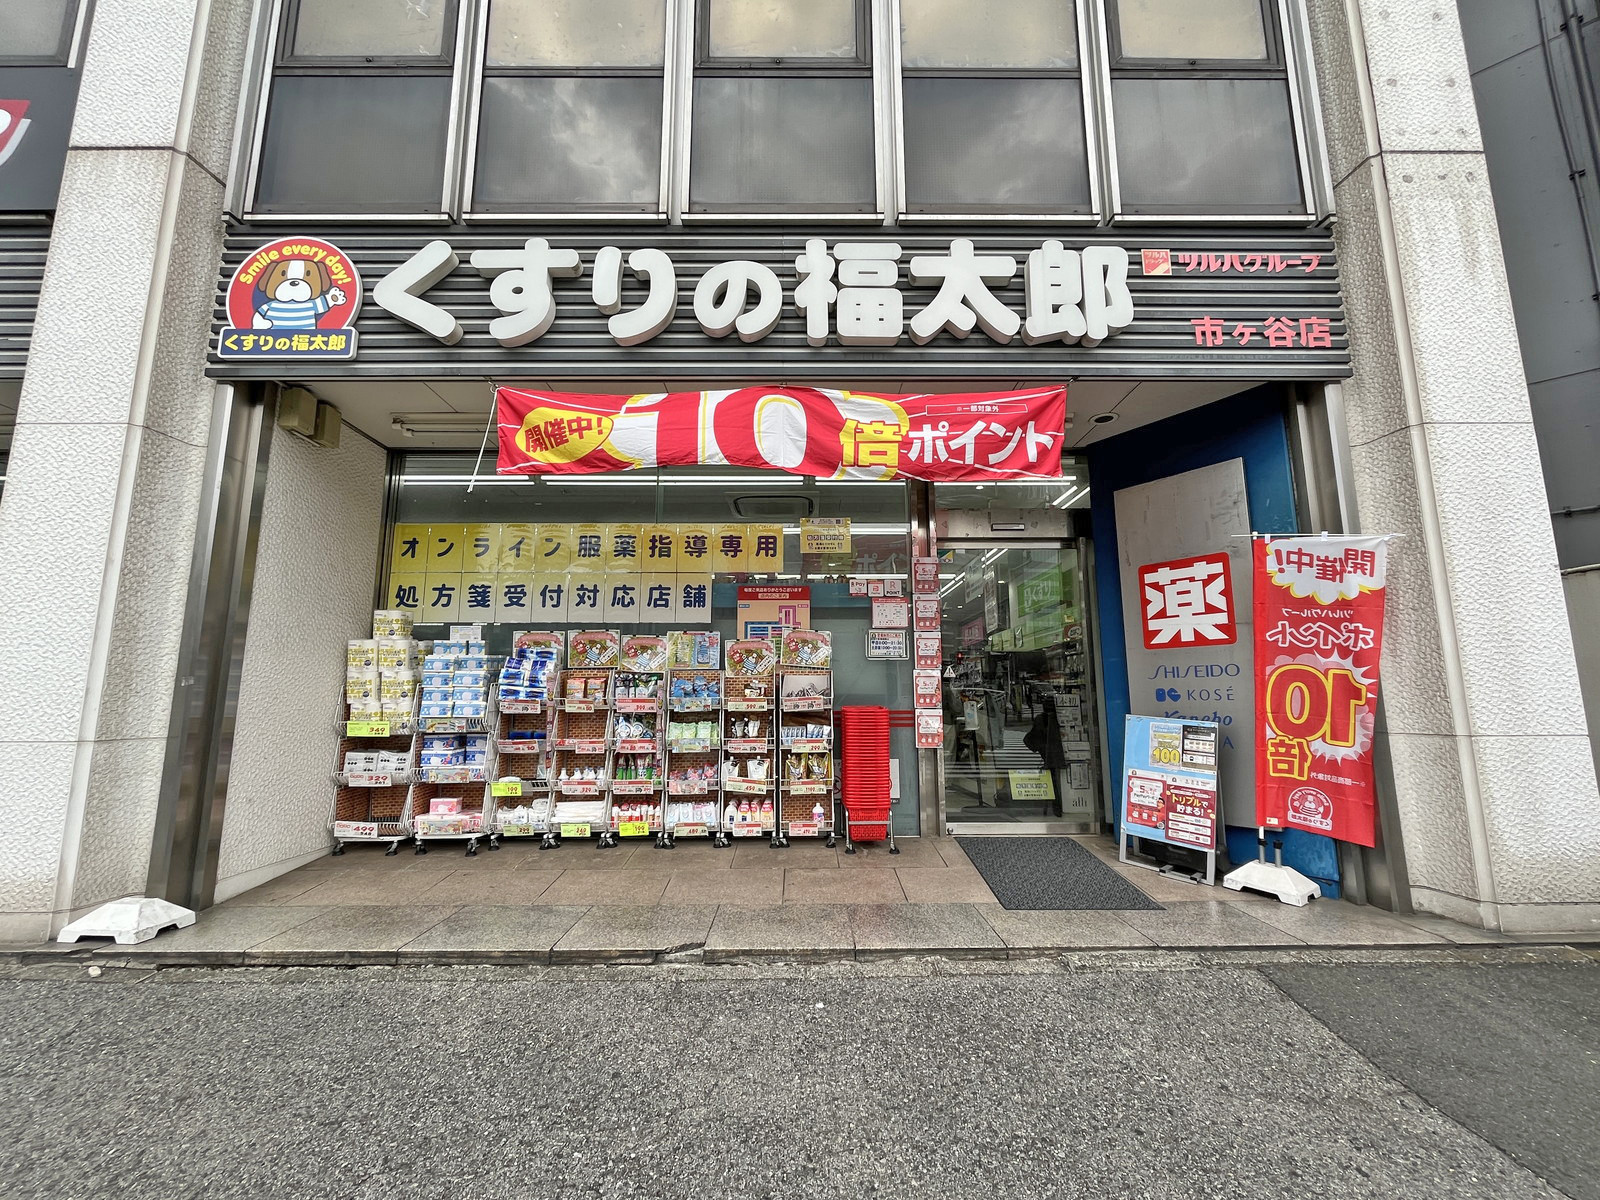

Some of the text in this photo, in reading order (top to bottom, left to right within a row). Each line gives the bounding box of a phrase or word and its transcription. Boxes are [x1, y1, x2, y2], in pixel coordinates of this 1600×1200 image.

[240, 245, 352, 285] Smile every day!
[1177, 253, 1321, 273] ツルハグループ
[372, 237, 1135, 347] くすりの福太郎
[224, 334, 346, 351] くすりの福太郎
[401, 534, 778, 559] オンライン服薬指導専用
[395, 583, 707, 608] 処方箋受付対応店舗
[1143, 560, 1230, 645] 薬
[1147, 663, 1241, 680] SHISEIDO
[1187, 686, 1236, 701] KOSÉ
[1172, 794, 1208, 808] トリプルで
